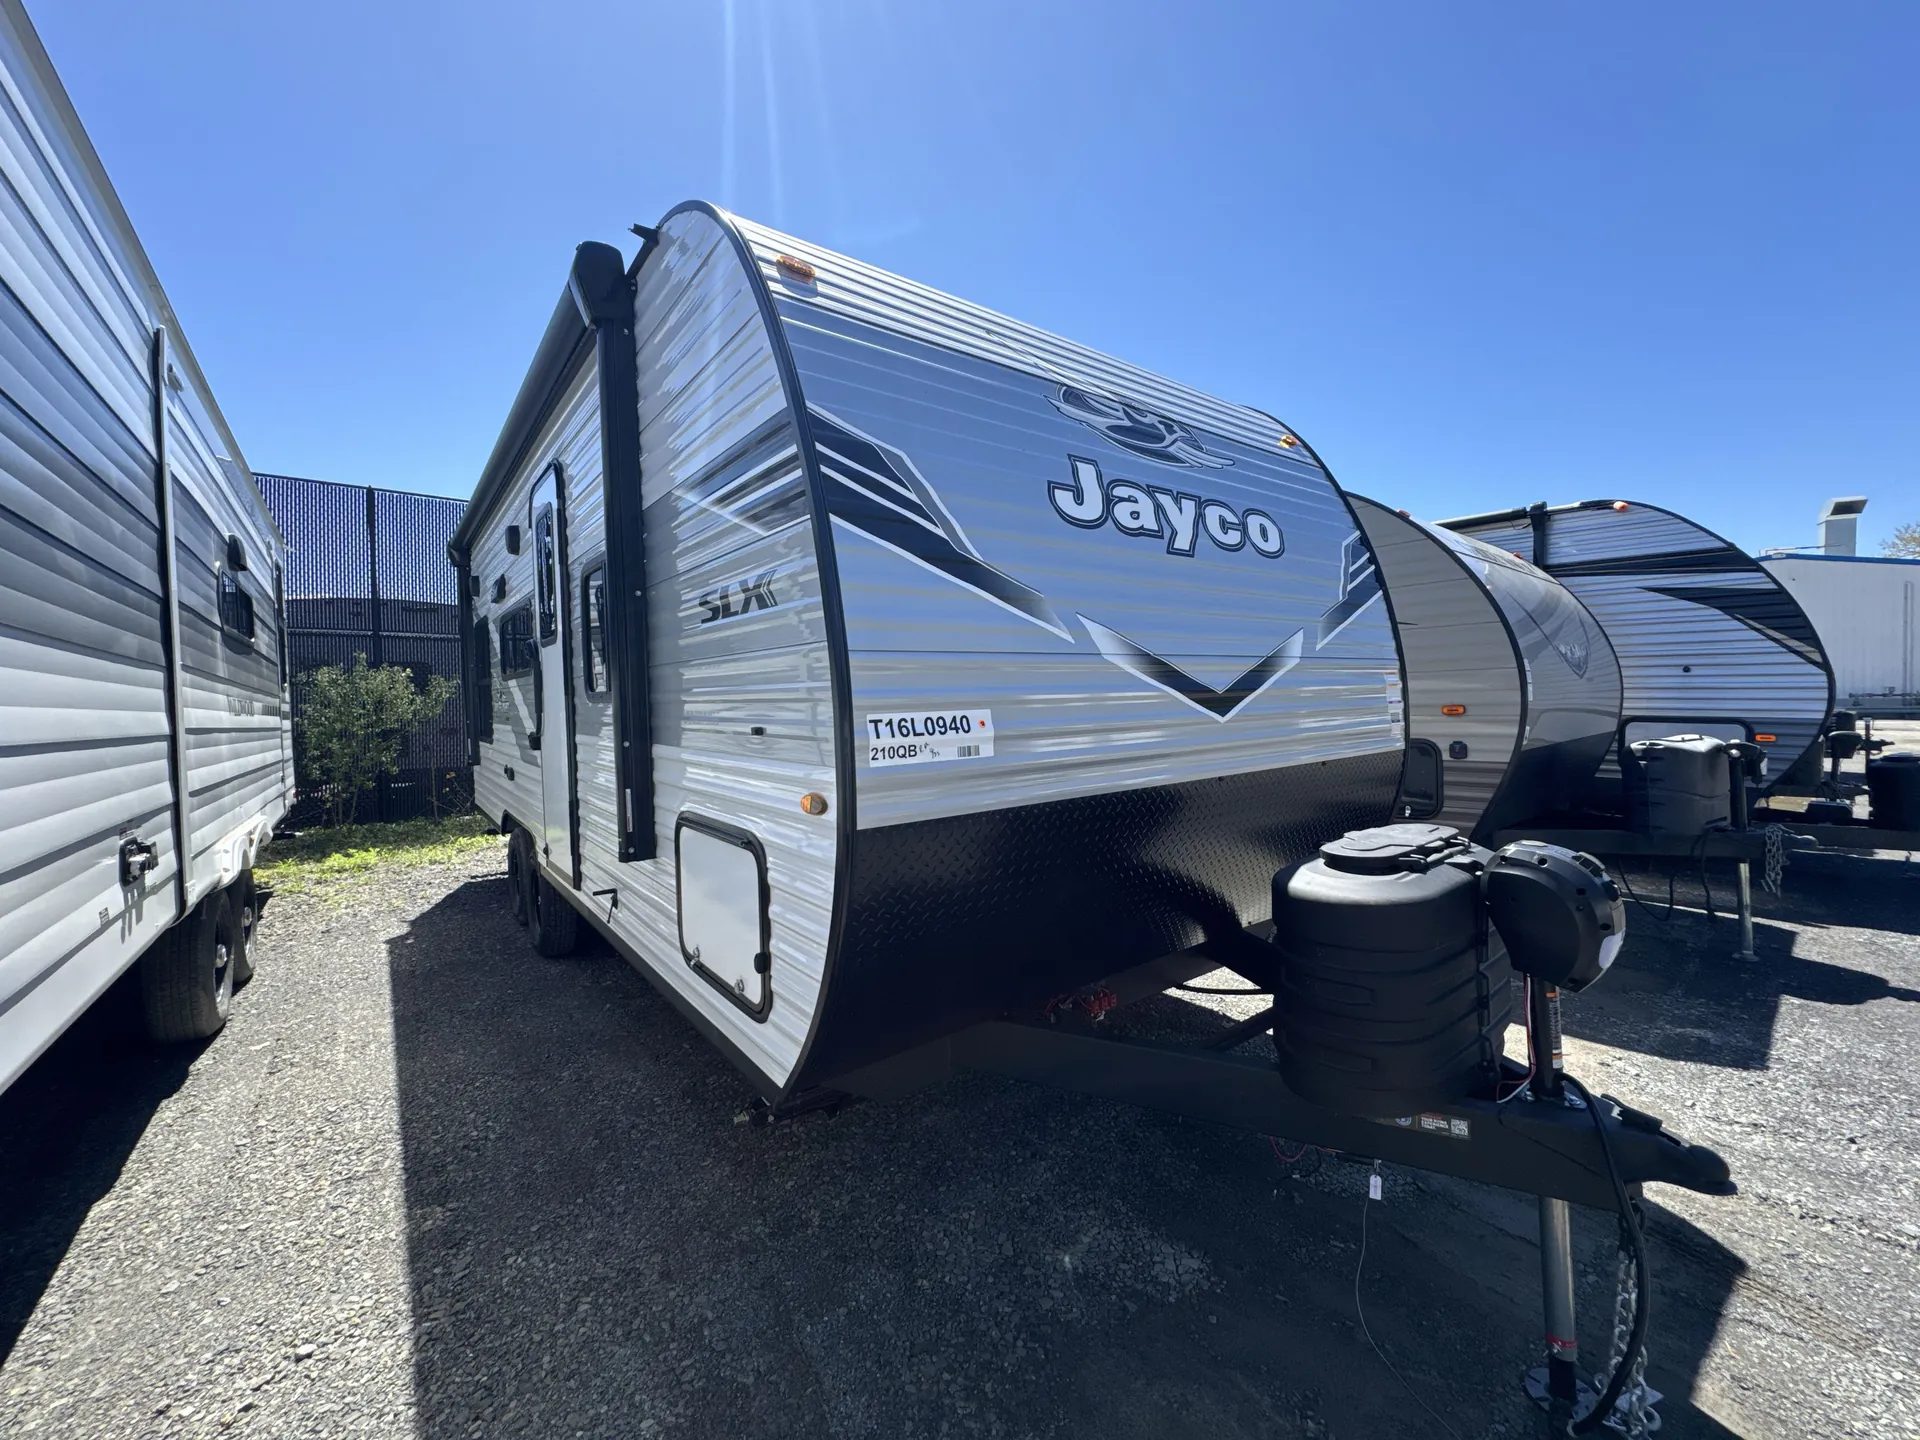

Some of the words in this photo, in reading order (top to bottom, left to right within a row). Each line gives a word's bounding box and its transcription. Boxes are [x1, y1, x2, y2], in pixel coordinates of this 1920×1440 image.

[1047, 453, 1286, 559] Jayco
[698, 568, 779, 625] SLX
[868, 714, 972, 740] T16L0940
[870, 743, 918, 761] 210QB
